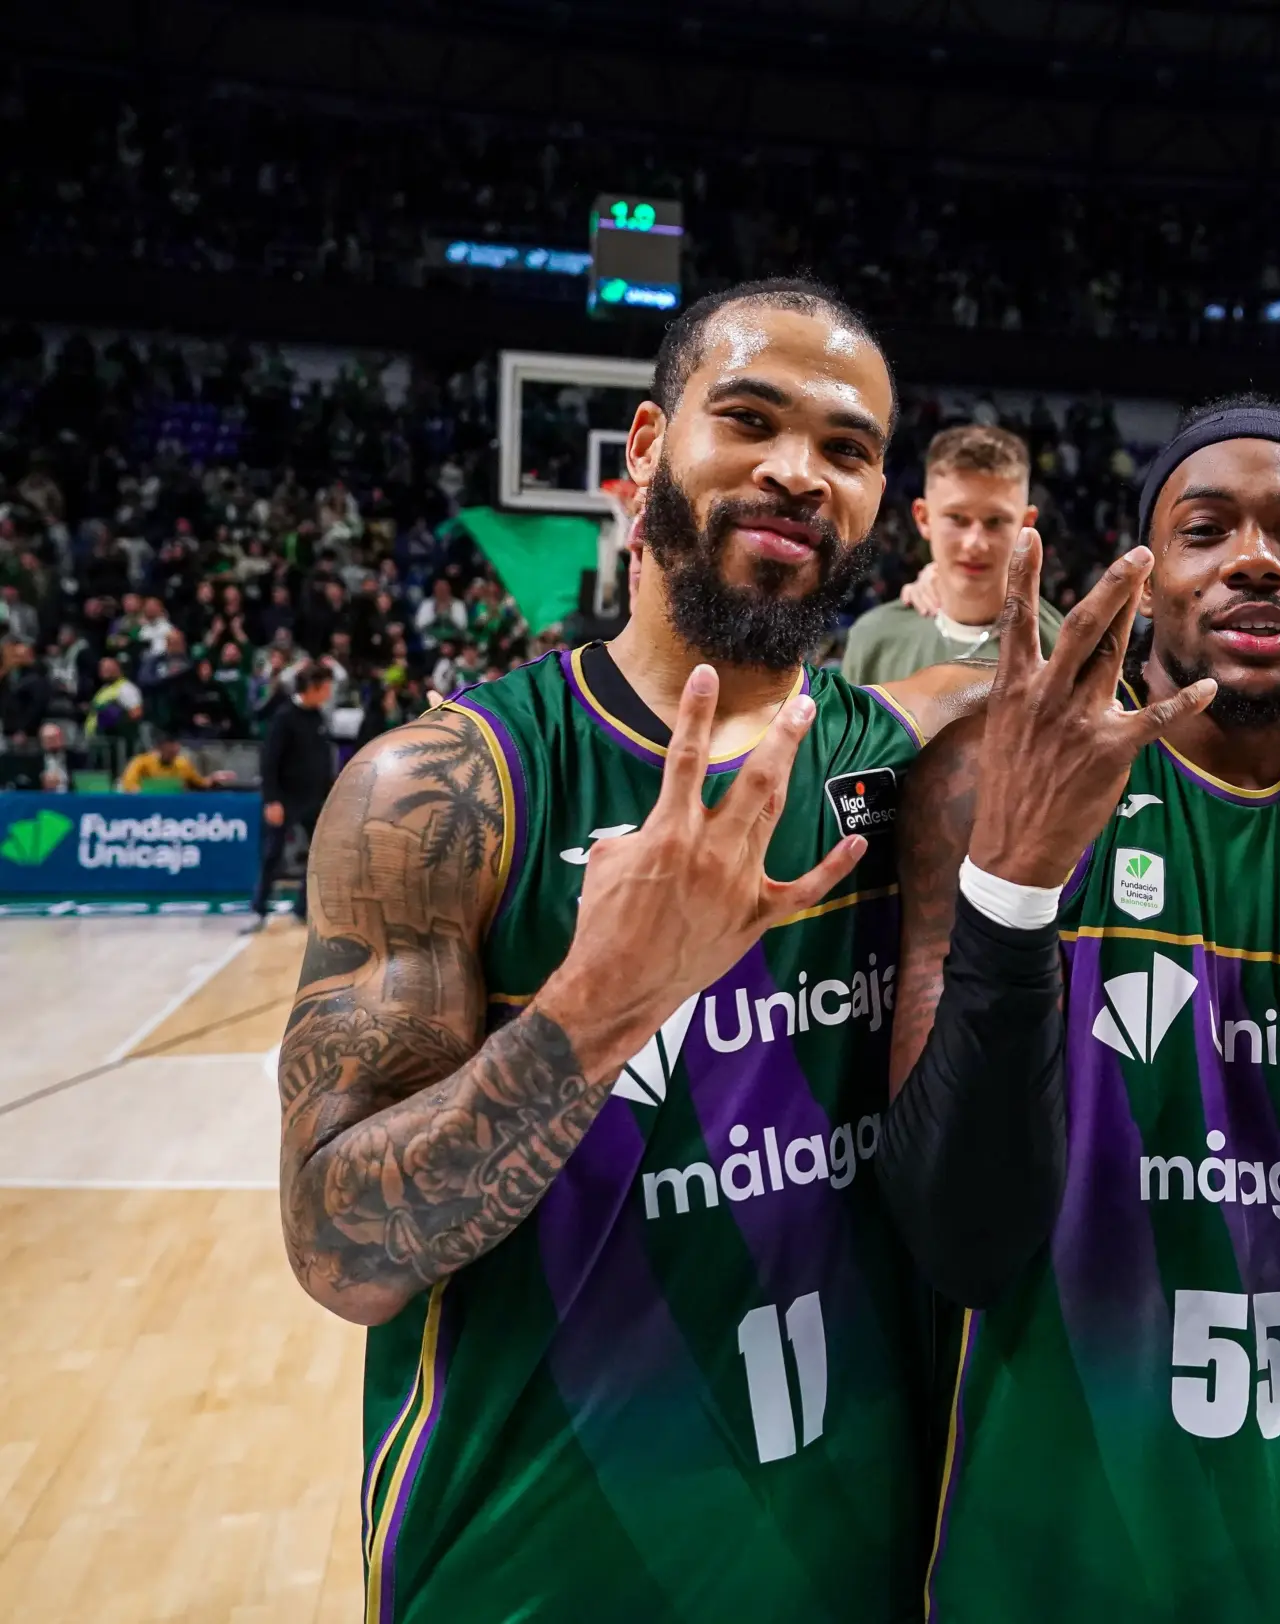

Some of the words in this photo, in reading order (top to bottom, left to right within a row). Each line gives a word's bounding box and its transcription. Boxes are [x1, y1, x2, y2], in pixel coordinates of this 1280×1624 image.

[840, 795, 866, 813] liga
[80, 812, 248, 843] Fundación
[78, 838, 201, 875] Unicaja
[1120, 879, 1158, 893] Fundación
[1120, 897, 1159, 909] Baloncesto
[1126, 889, 1153, 902] Unicaja
[738, 1290, 828, 1464] 11
